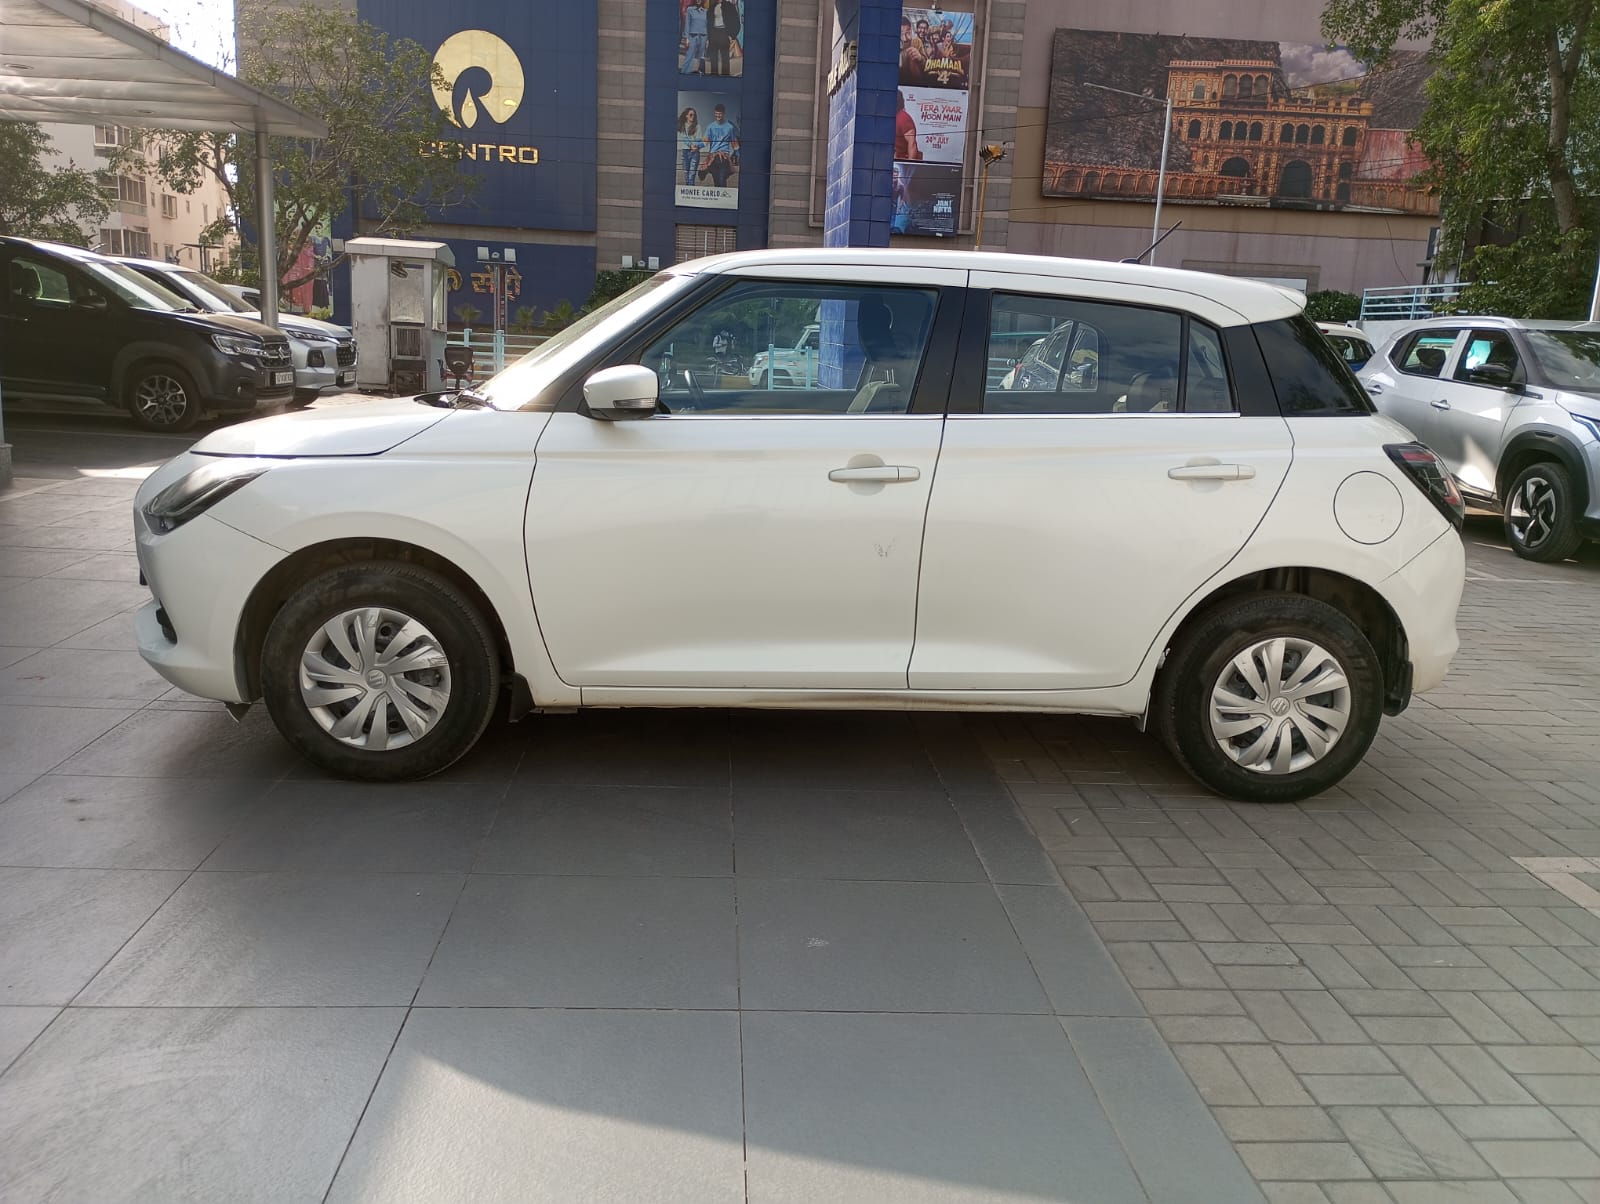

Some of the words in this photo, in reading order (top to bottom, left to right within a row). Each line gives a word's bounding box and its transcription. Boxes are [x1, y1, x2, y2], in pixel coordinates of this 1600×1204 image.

[920, 103, 939, 113] TERA
[941, 104, 963, 114] YAAR
[921, 111, 941, 122] HOON
[943, 113, 962, 122] MAIN
[937, 136, 950, 145] JULY
[680, 188, 700, 196] MONTE
[701, 189, 721, 198] CARLO
